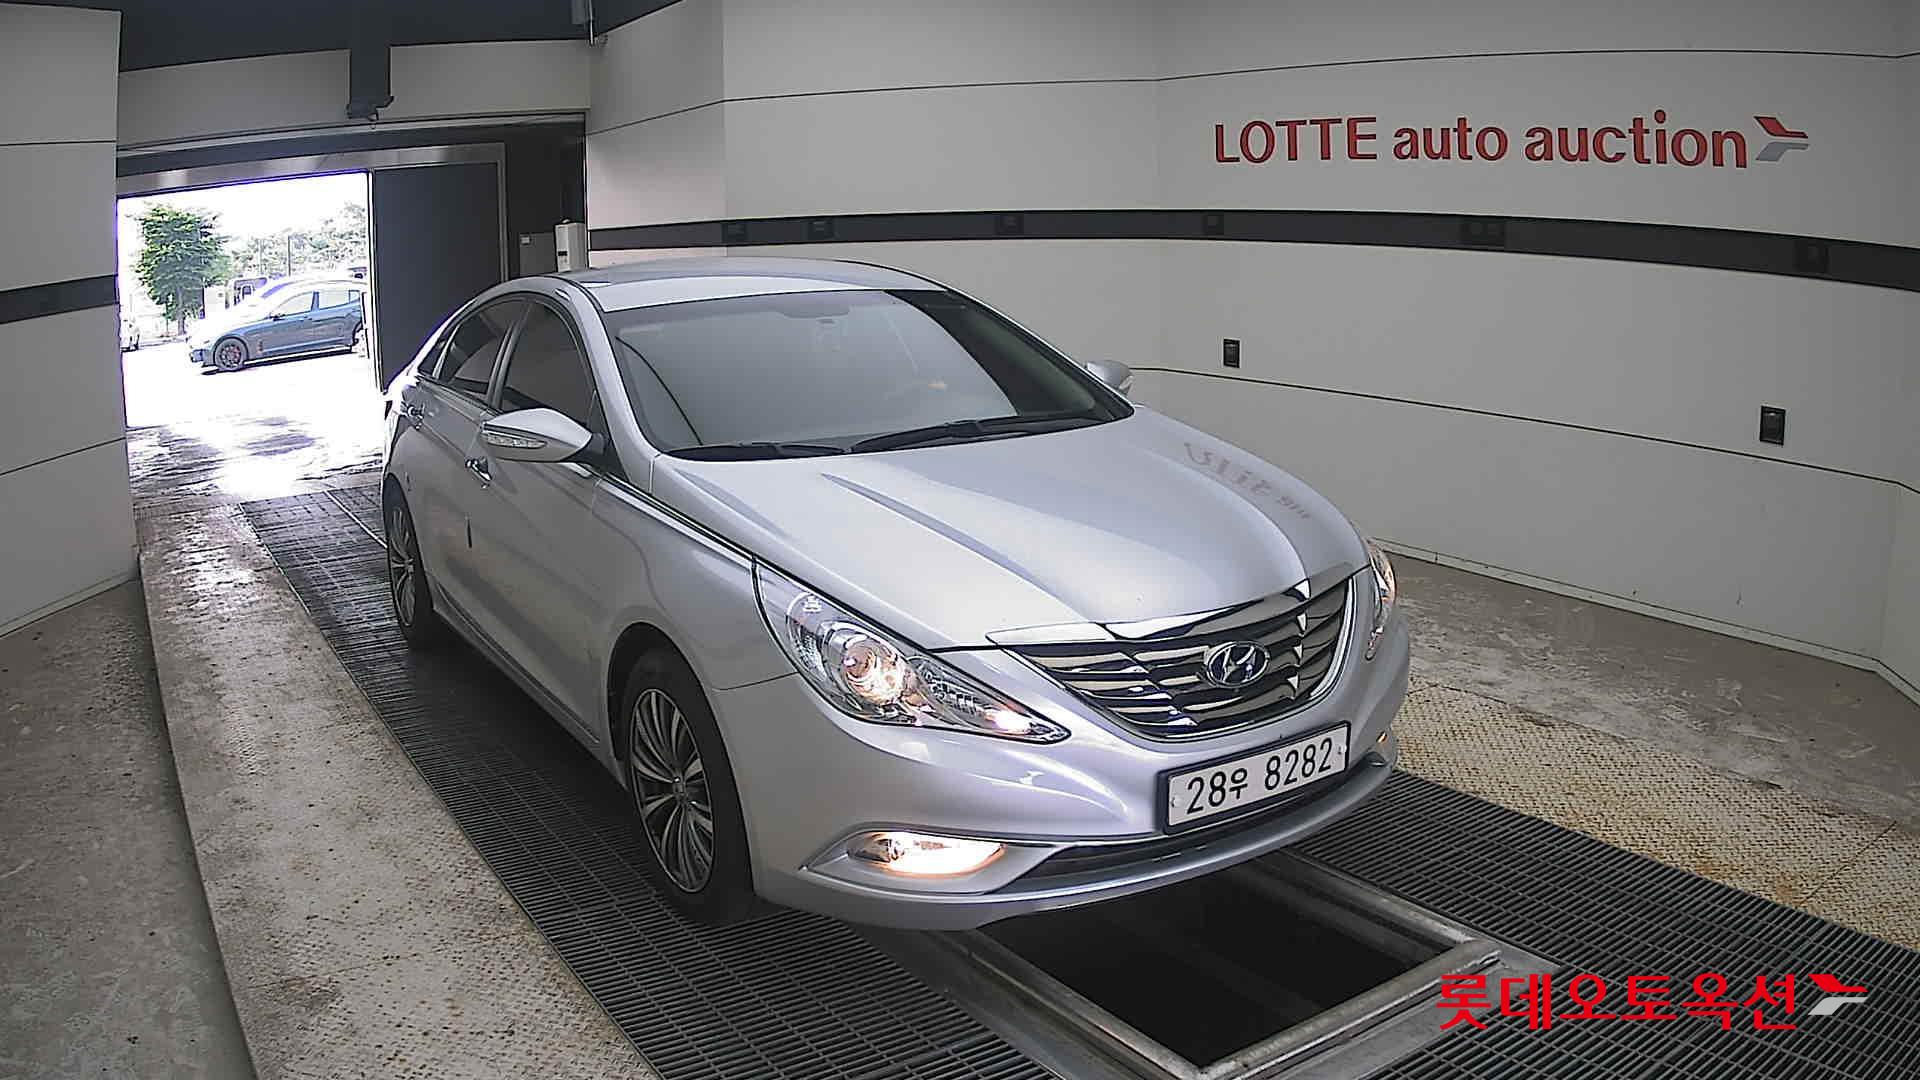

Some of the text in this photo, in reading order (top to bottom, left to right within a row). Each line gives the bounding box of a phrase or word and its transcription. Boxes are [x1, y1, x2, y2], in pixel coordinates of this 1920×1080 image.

[1215, 109, 1748, 168] LOTTE auto auction
[1186, 737, 1333, 815] 28우 8282
